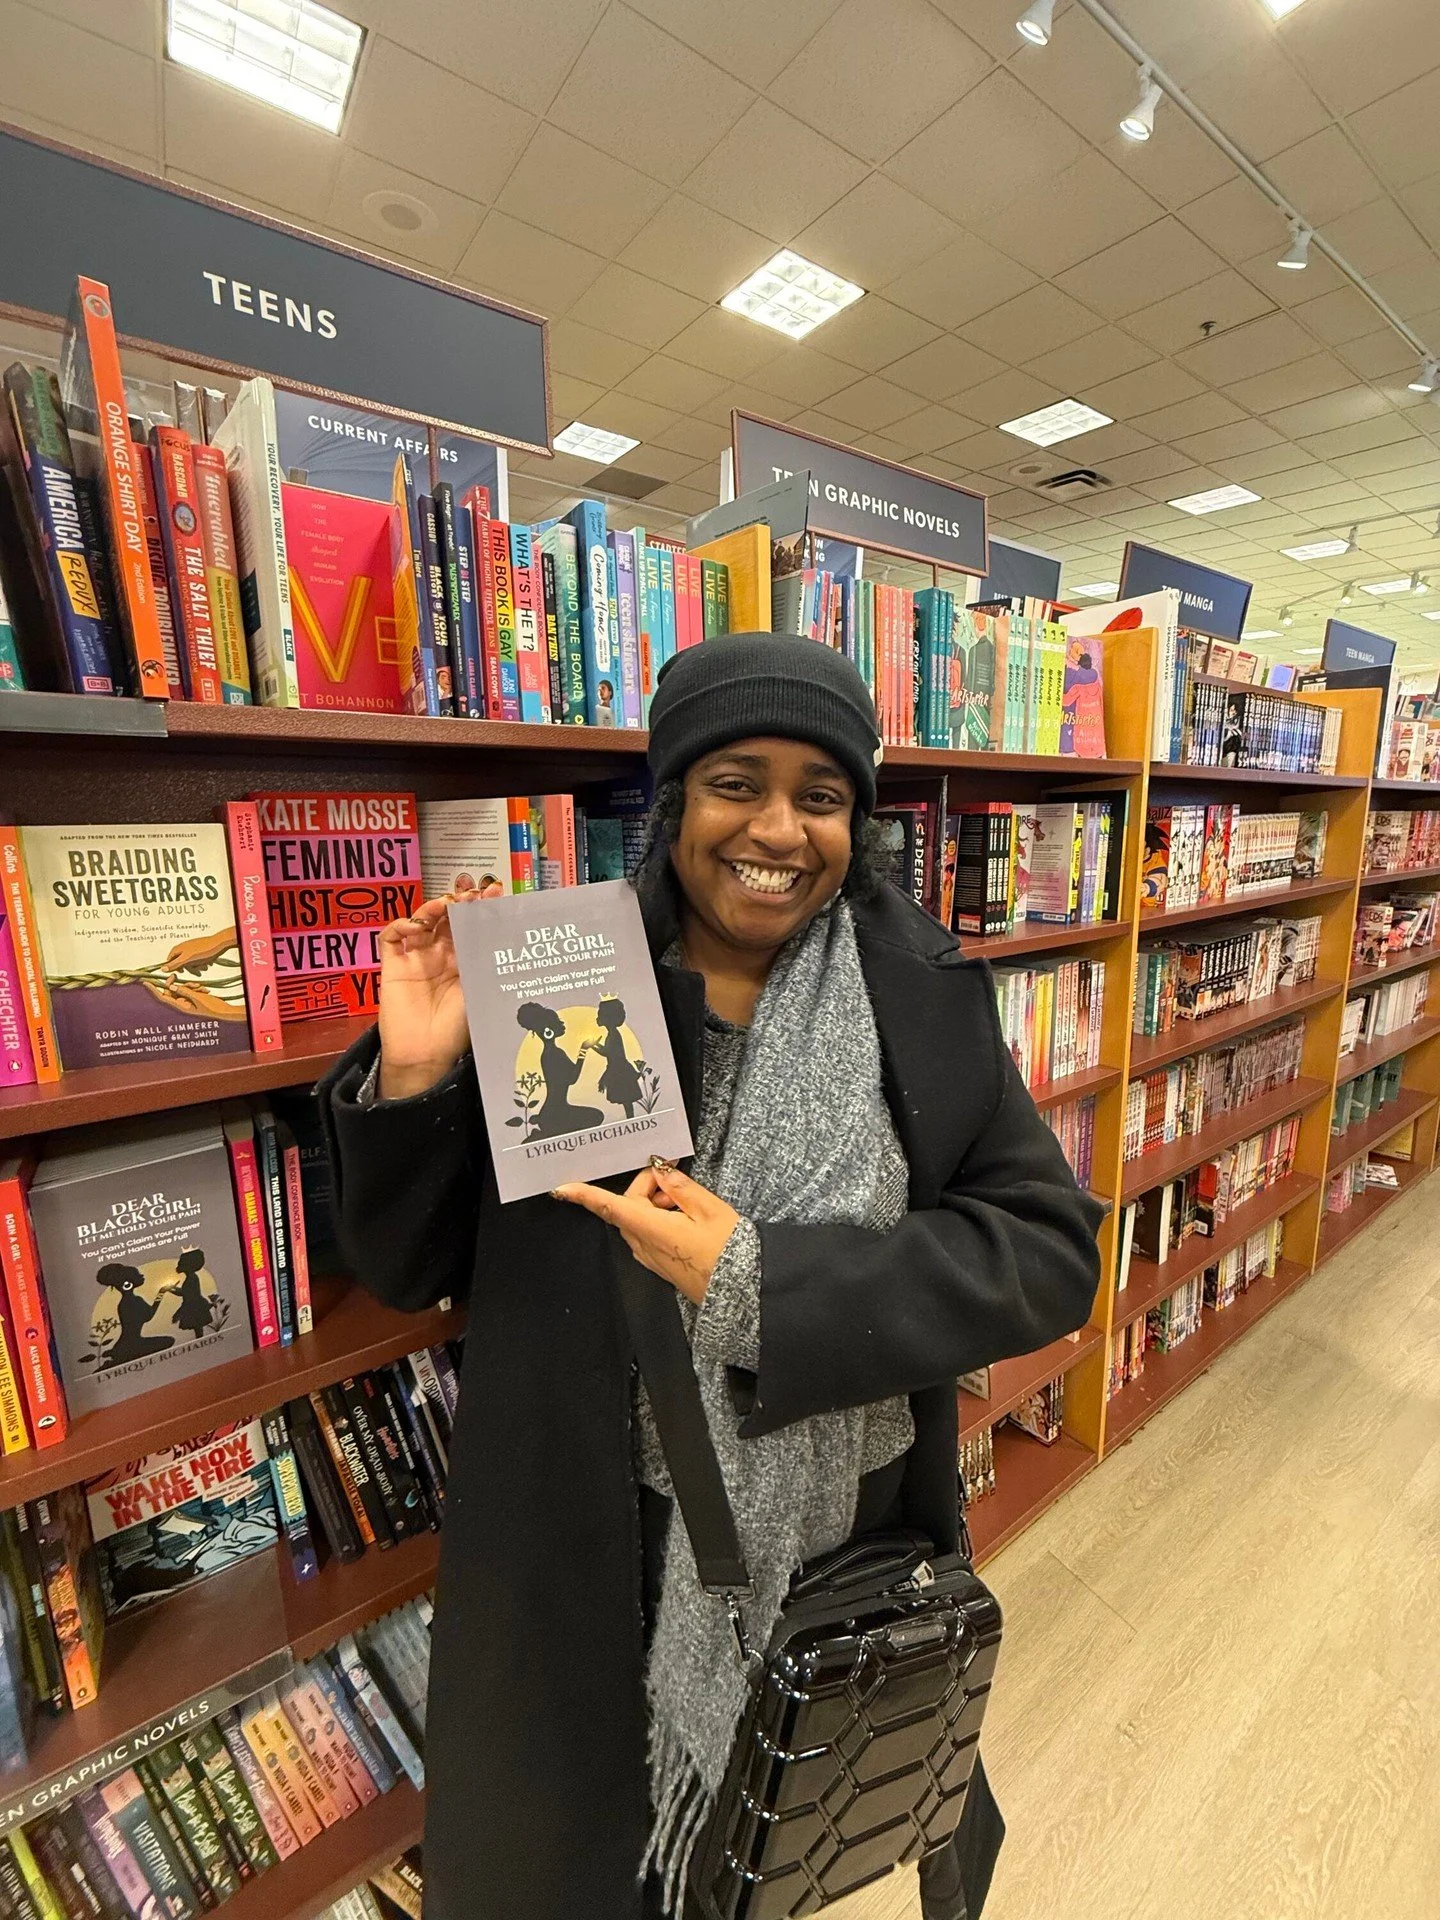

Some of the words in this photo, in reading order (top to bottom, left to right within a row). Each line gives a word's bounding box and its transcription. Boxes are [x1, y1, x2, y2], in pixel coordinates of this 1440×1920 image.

[202, 271, 337, 339] TEENS
[106, 402, 129, 472] ORANGE
[308, 416, 388, 445] CURRENT
[395, 437, 458, 462] AFFARS
[267, 442, 277, 468] YOUR
[117, 473, 138, 519] SHIRT
[269, 468, 280, 513] RECOVERY,
[43, 466, 84, 548] AMERICA
[825, 484, 899, 520] GRAPHIC
[904, 507, 960, 538] NOVELS
[123, 521, 143, 553] DAY
[274, 517, 282, 538] YOUR
[426, 512, 437, 544] CASSIDY
[491, 527, 506, 561] THIS
[184, 545, 204, 574] THE
[515, 532, 531, 593] WHAT'S
[646, 558, 658, 590] LIVE
[62, 556, 97, 614] REDUX
[280, 573, 288, 604] TEENS
[433, 564, 444, 599] BLACK
[494, 564, 510, 609] BOOK
[564, 554, 578, 611] BEYOND
[661, 560, 672, 592] LIVE
[676, 564, 688, 595] LIVE
[690, 568, 700, 598] LIVE
[705, 570, 716, 600] LIVE
[717, 574, 727, 603] LIVE
[187, 580, 209, 620] SALT
[520, 599, 533, 630] THE
[1184, 593, 1214, 612] MANGA
[437, 614, 449, 647] YOUR
[497, 611, 511, 626] IS
[545, 613, 556, 632] BAN
[568, 618, 579, 644] THE
[194, 625, 216, 672] THIEF
[497, 629, 513, 659] GAY
[522, 634, 535, 652] T?
[547, 635, 558, 661] THIS!
[1346, 648, 1357, 659] TEEN
[1358, 651, 1375, 664] MANGA
[488, 656, 497, 673] SEAN
[570, 652, 584, 699] BOARD
[316, 693, 394, 709] BOHANNON
[489, 673, 499, 699] COVEY
[950, 689, 989, 705] ARTSTOPPER
[1061, 711, 1100, 726] ARTSTOPPER
[259, 799, 320, 831] KATE
[327, 799, 411, 830] MOSSE
[241, 812, 256, 852] Stephanie
[2, 843, 19, 873] Collins
[68, 848, 197, 877] BRAIDING
[262, 838, 412, 882] FEMINIST
[912, 848, 926, 888] DEEP
[52, 875, 219, 908] SWEETGRASS
[75, 909, 100, 920] FOR
[107, 907, 150, 918] YOUNG
[158, 904, 205, 915] ADULTS
[267, 885, 416, 930] HISTORY
[337, 911, 380, 925] FOR
[525, 923, 579, 945] DEAR
[272, 932, 359, 971] EVERY
[494, 941, 561, 965] BLACK
[563, 934, 614, 953] GIRL,
[497, 964, 516, 975] LET
[517, 961, 532, 972] ME
[533, 957, 561, 968] HOLD
[563, 951, 591, 963] YOUR
[592, 948, 615, 958] PAIN
[312, 979, 341, 993] OF
[500, 983, 518, 992] You
[519, 977, 542, 988] Can't
[543, 973, 569, 983] Claim
[570, 969, 590, 979] Your
[591, 965, 616, 975] Power
[517, 990, 524, 999] If
[524, 987, 544, 997] Your
[546, 982, 574, 993] Hands
[590, 976, 605, 985] Full
[298, 992, 342, 1009] THE
[95, 1029, 128, 1040] ROBIN
[135, 1027, 162, 1035] WALL
[168, 1021, 220, 1032] KIMMERER
[132, 1035, 167, 1044] MONIQUE
[195, 1030, 218, 1038] SMITH
[100, 1048, 136, 1057] ILLUSTRATIONS
[146, 1043, 174, 1052] NICOLE
[177, 1039, 220, 1049] NEIDHARDT
[526, 1135, 587, 1159] LYRIQUE
[589, 1118, 658, 1143] RICHARDS
[269, 1176, 280, 1194] THIS
[77, 1210, 145, 1238] BLACK
[150, 1197, 200, 1218] GIRL,
[111, 1193, 167, 1216] DEAR
[271, 1195, 282, 1218] LAND
[4, 1213, 17, 1235] BORN
[79, 1237, 99, 1246] LET
[100, 1231, 115, 1240] ME
[117, 1223, 146, 1236] HOLD
[148, 1214, 176, 1227] YOUR
[178, 1208, 200, 1219] PAIN
[274, 1218, 283, 1227] IS
[275, 1228, 285, 1245] OUR
[9, 1243, 21, 1261] GIRL
[81, 1250, 99, 1259] You
[101, 1242, 125, 1254] Can't
[126, 1235, 152, 1247] Claim
[154, 1230, 174, 1239] Your
[175, 1222, 200, 1233] Power
[106, 1251, 127, 1260] Your
[128, 1243, 156, 1254] Hands
[173, 1233, 188, 1242] Full
[276, 1246, 287, 1268] LAND
[97, 1359, 157, 1383] LYRIQUE
[158, 1335, 224, 1361] RICHARDS
[0, 1371, 12, 1389] LEE
[0, 1389, 21, 1432] SIMMONS
[352, 1404, 370, 1431] OVER
[361, 1429, 375, 1445] MY
[105, 1466, 187, 1510] WAKE
[189, 1433, 249, 1477] NOW
[337, 1431, 371, 1487] BLACKWATER
[364, 1444, 384, 1472] DEAD
[112, 1503, 143, 1530] IN
[148, 1479, 198, 1514] THE
[202, 1450, 255, 1490] FIRE
[374, 1470, 394, 1497] BODY
[32, 1744, 128, 1807] GRAPHIC
[134, 1700, 210, 1750] NOVELS
[133, 1820, 177, 1891] VISITATIONS
